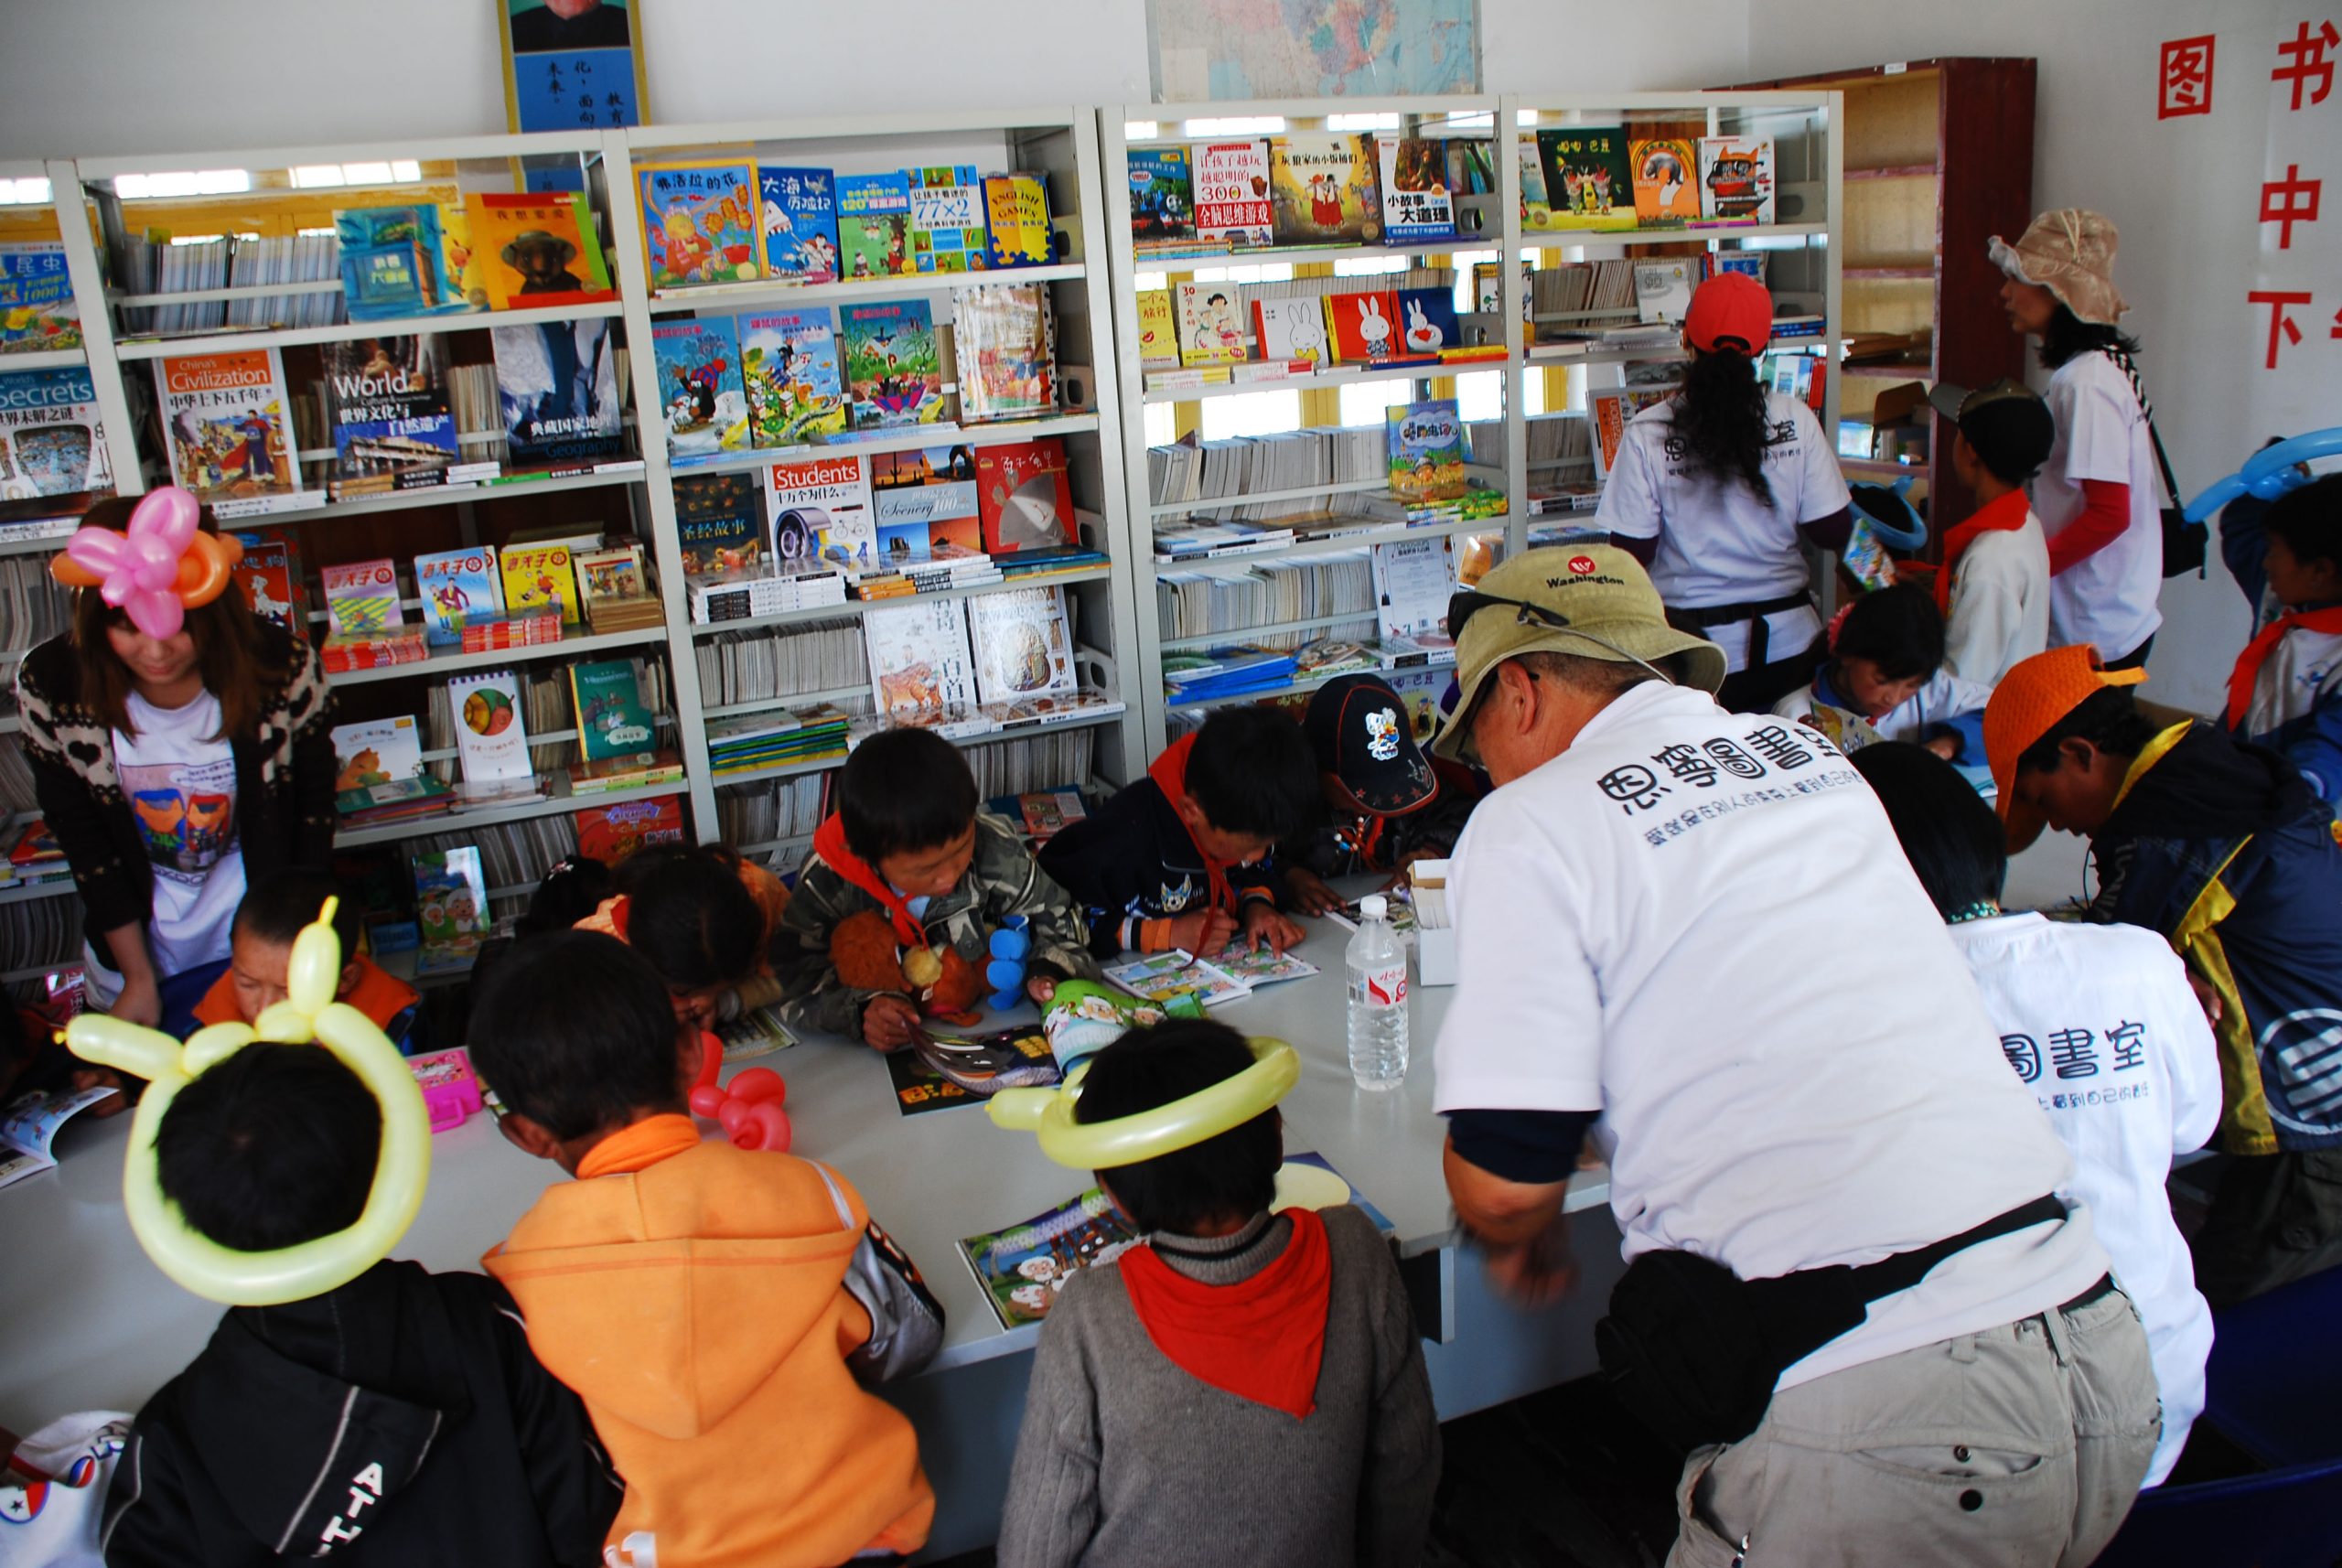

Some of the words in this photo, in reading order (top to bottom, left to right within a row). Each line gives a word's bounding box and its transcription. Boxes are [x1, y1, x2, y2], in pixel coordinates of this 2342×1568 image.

[1200, 155, 1261, 167] 让孩子越玩
[657, 172, 737, 191] 弗洛拉的花
[762, 177, 800, 195] 大海
[1200, 170, 1250, 184] 越聪明的
[788, 196, 831, 211] 历险记
[993, 188, 1040, 206] ENGLISH
[1388, 194, 1424, 208] 小故事
[1200, 204, 1269, 227] 全脑思维游戏
[1400, 208, 1450, 223] 大道理
[16, 255, 60, 274] 昆虫
[179, 360, 217, 371] China's
[171, 368, 268, 391] Civilization
[335, 368, 408, 399] World
[170, 388, 263, 409] 中华上下五千年
[339, 403, 410, 424] 世界文化与
[544, 437, 620, 457] Geography
[776, 464, 858, 489] Students
[778, 487, 840, 505] 十万个为什么
[881, 502, 932, 519] Scenery
[932, 498, 958, 512] 100
[1546, 574, 1625, 589] Washington
